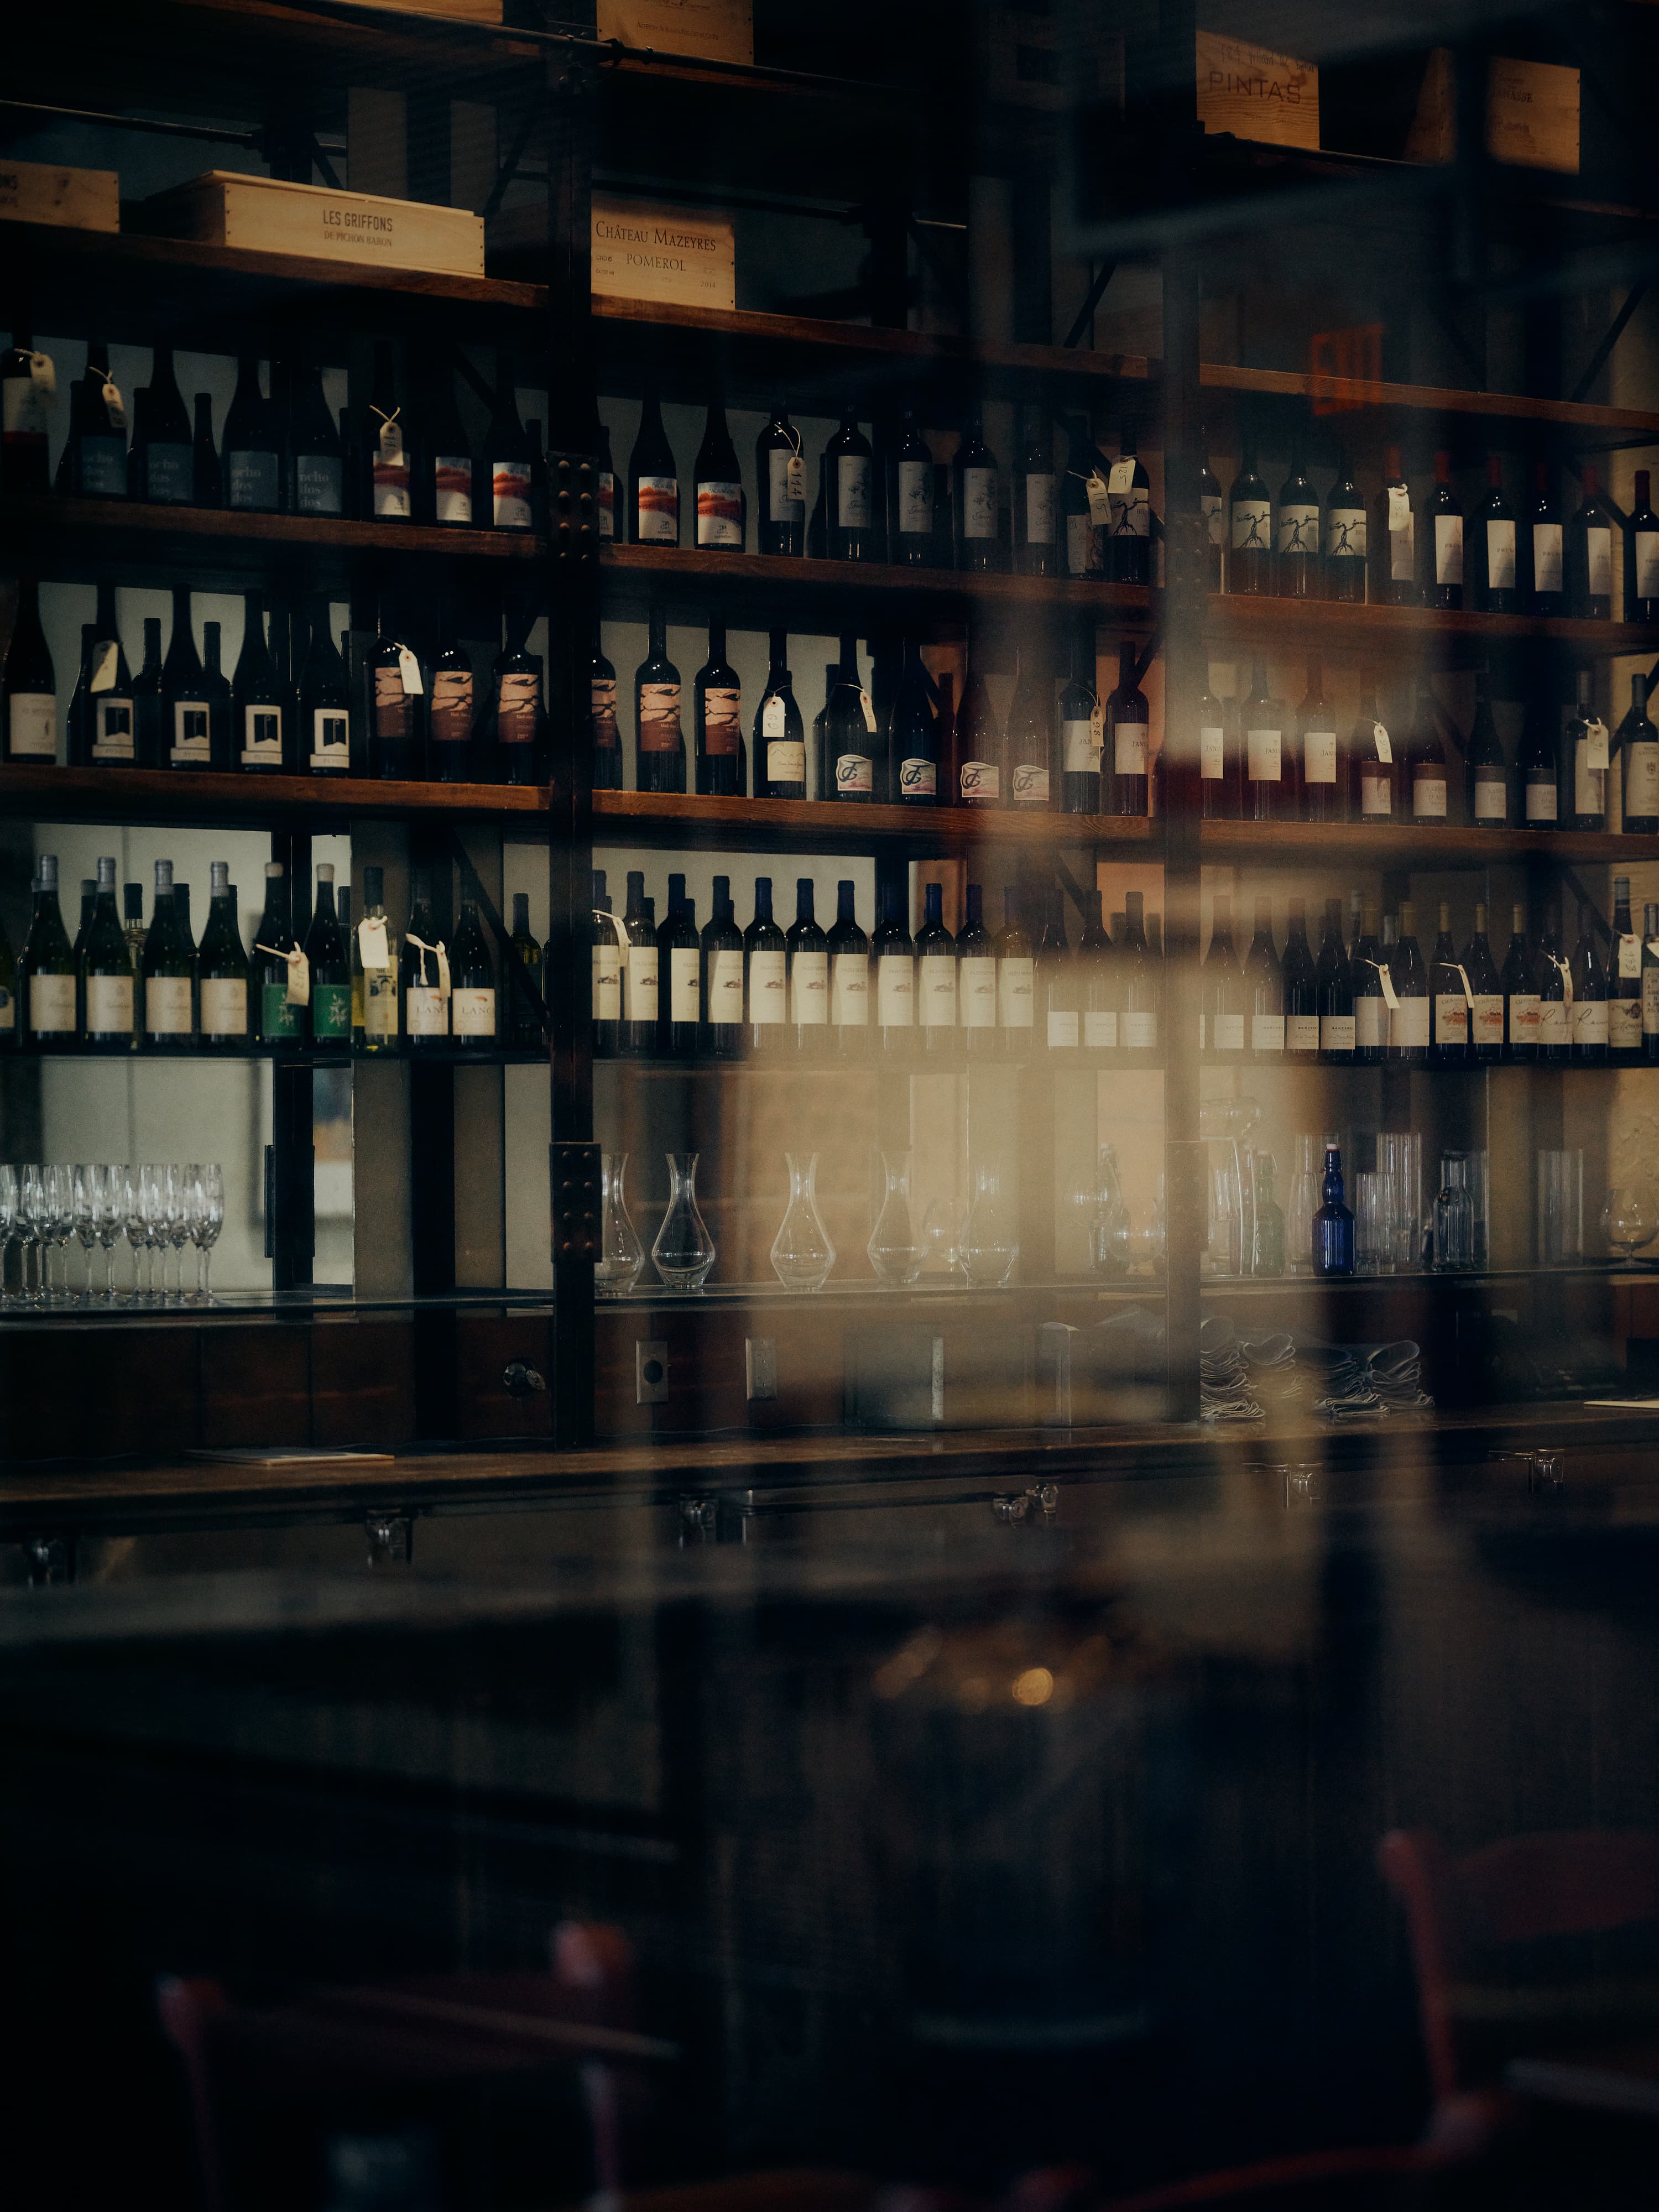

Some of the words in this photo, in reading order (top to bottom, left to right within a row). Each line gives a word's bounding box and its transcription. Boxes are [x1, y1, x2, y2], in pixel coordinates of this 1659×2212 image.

[1209, 70, 1301, 104] PINTAS
[323, 210, 341, 226] LES
[345, 212, 393, 232] GRIFFONS
[324, 230, 335, 240] DE
[336, 231, 365, 244] PICHON
[366, 235, 392, 247] BARON
[654, 227, 717, 252] MAZEYRES
[627, 253, 686, 272] POMEROL
[790, 473, 802, 496] 114
[1119, 466, 1129, 486] 125
[1093, 492, 1109, 518] 115
